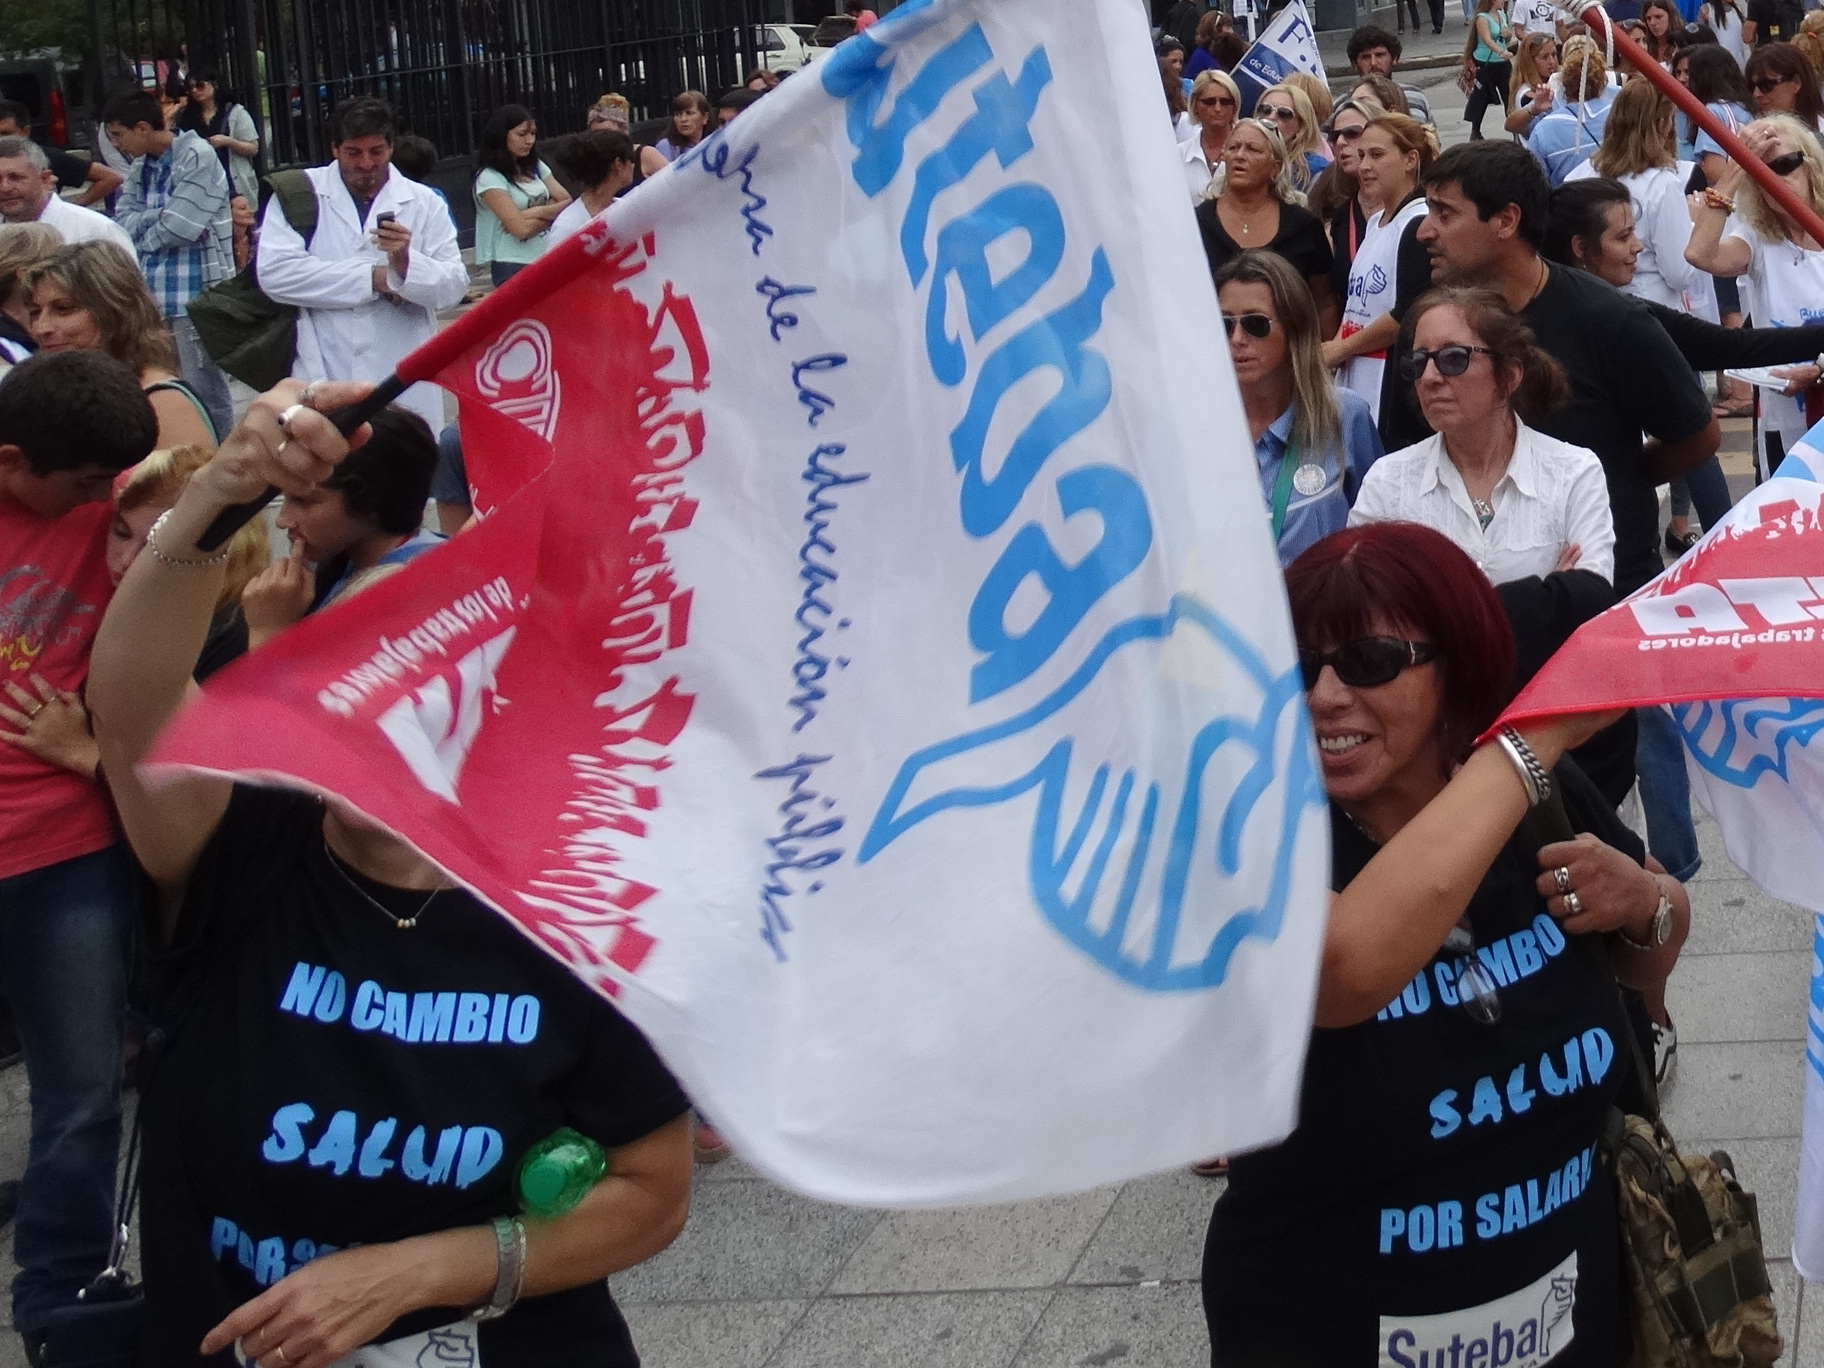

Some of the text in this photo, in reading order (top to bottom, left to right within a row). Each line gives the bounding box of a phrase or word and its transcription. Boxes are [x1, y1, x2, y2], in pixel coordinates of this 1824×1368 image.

[1249, 58, 1285, 84] de Educ
[755, 274, 817, 343] de
[791, 352, 848, 428] la
[279, 961, 541, 1046] NO CAMBIO
[1434, 912, 1566, 1007] CAMBO
[1430, 1027, 1615, 1140] SALUD
[262, 1102, 504, 1190] SALUD
[1379, 1139, 1600, 1255] POR SALARI
[211, 1215, 287, 1286] POR
[1387, 1316, 1538, 1368] Suteba
